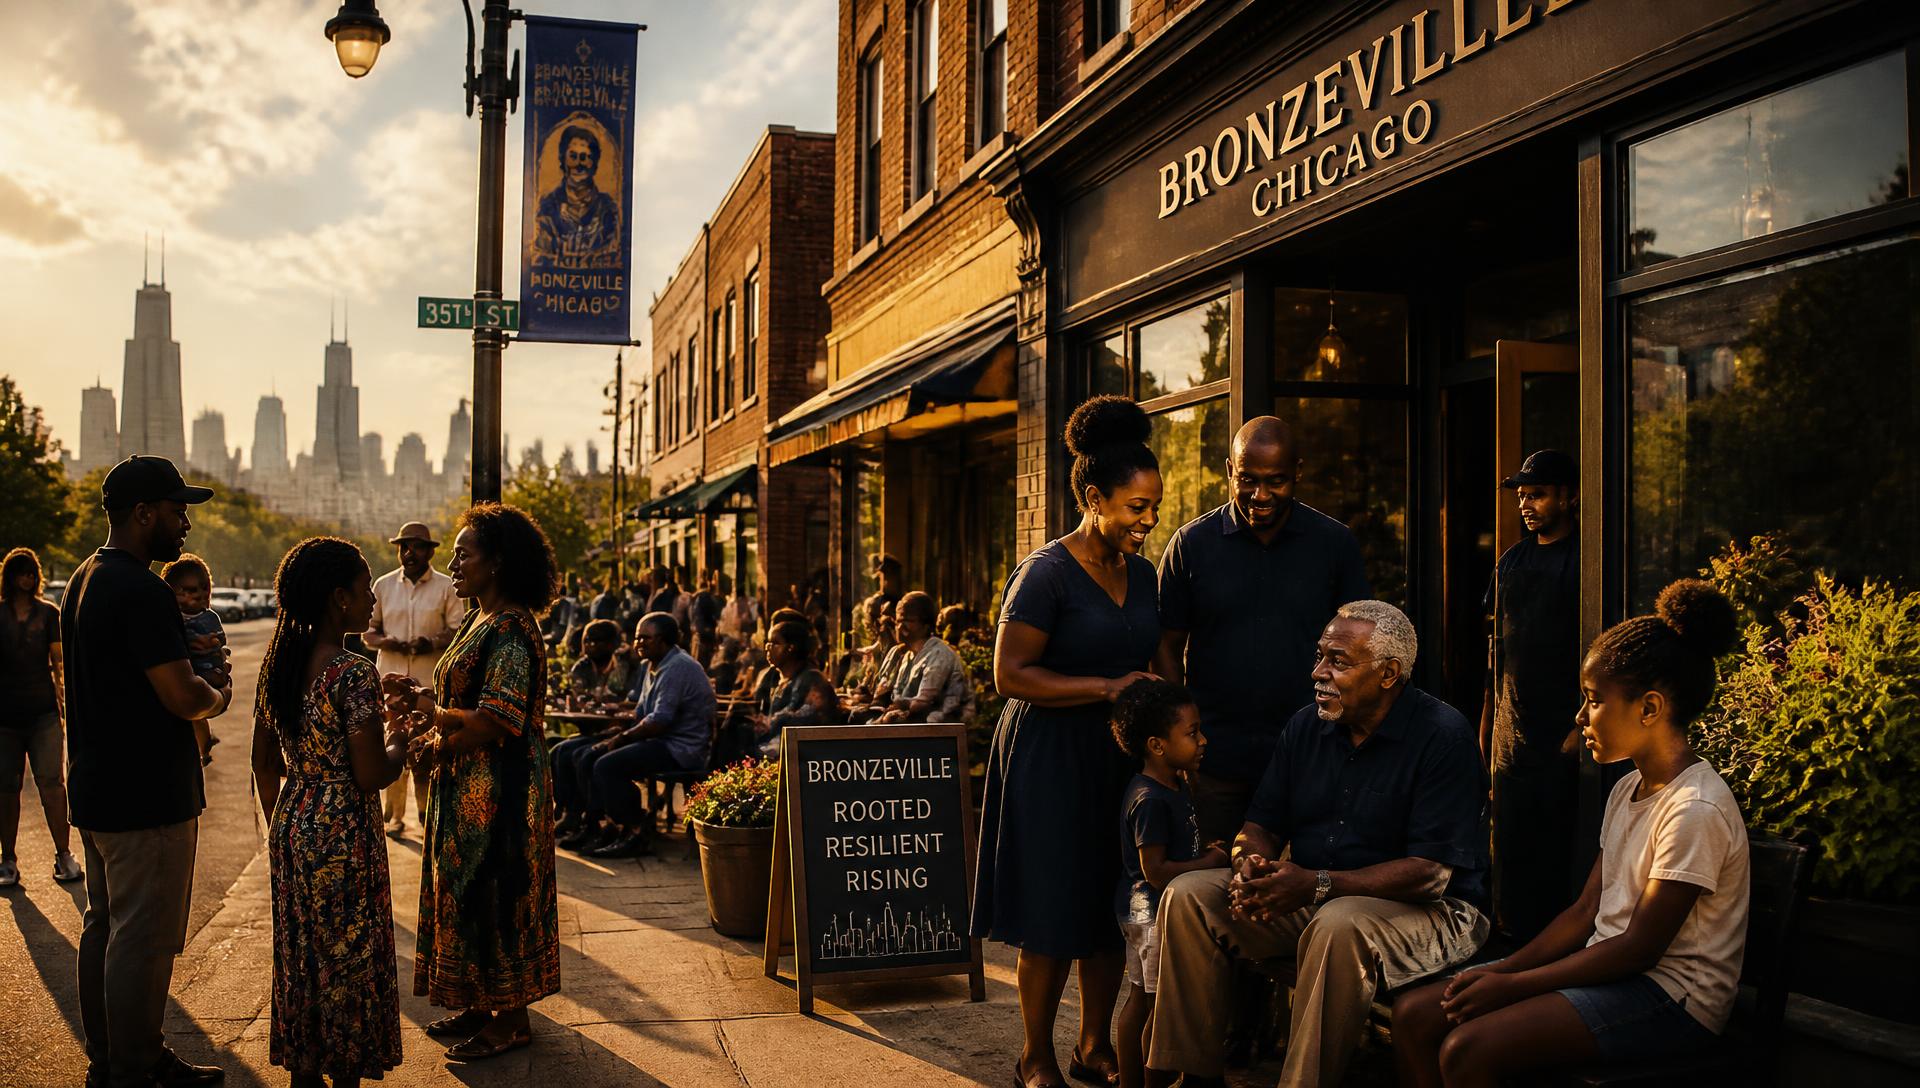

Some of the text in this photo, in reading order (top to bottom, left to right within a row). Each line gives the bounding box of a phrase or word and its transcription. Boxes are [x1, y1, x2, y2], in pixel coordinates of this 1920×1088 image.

[1251, 100, 1433, 217] CHICAGO
[487, 305, 514, 326] ST
[807, 757, 952, 783] BRONZEVILLE
[834, 798, 931, 823] ROOTED
[826, 833, 944, 858] RESILIENT
[846, 867, 928, 892] RISING
